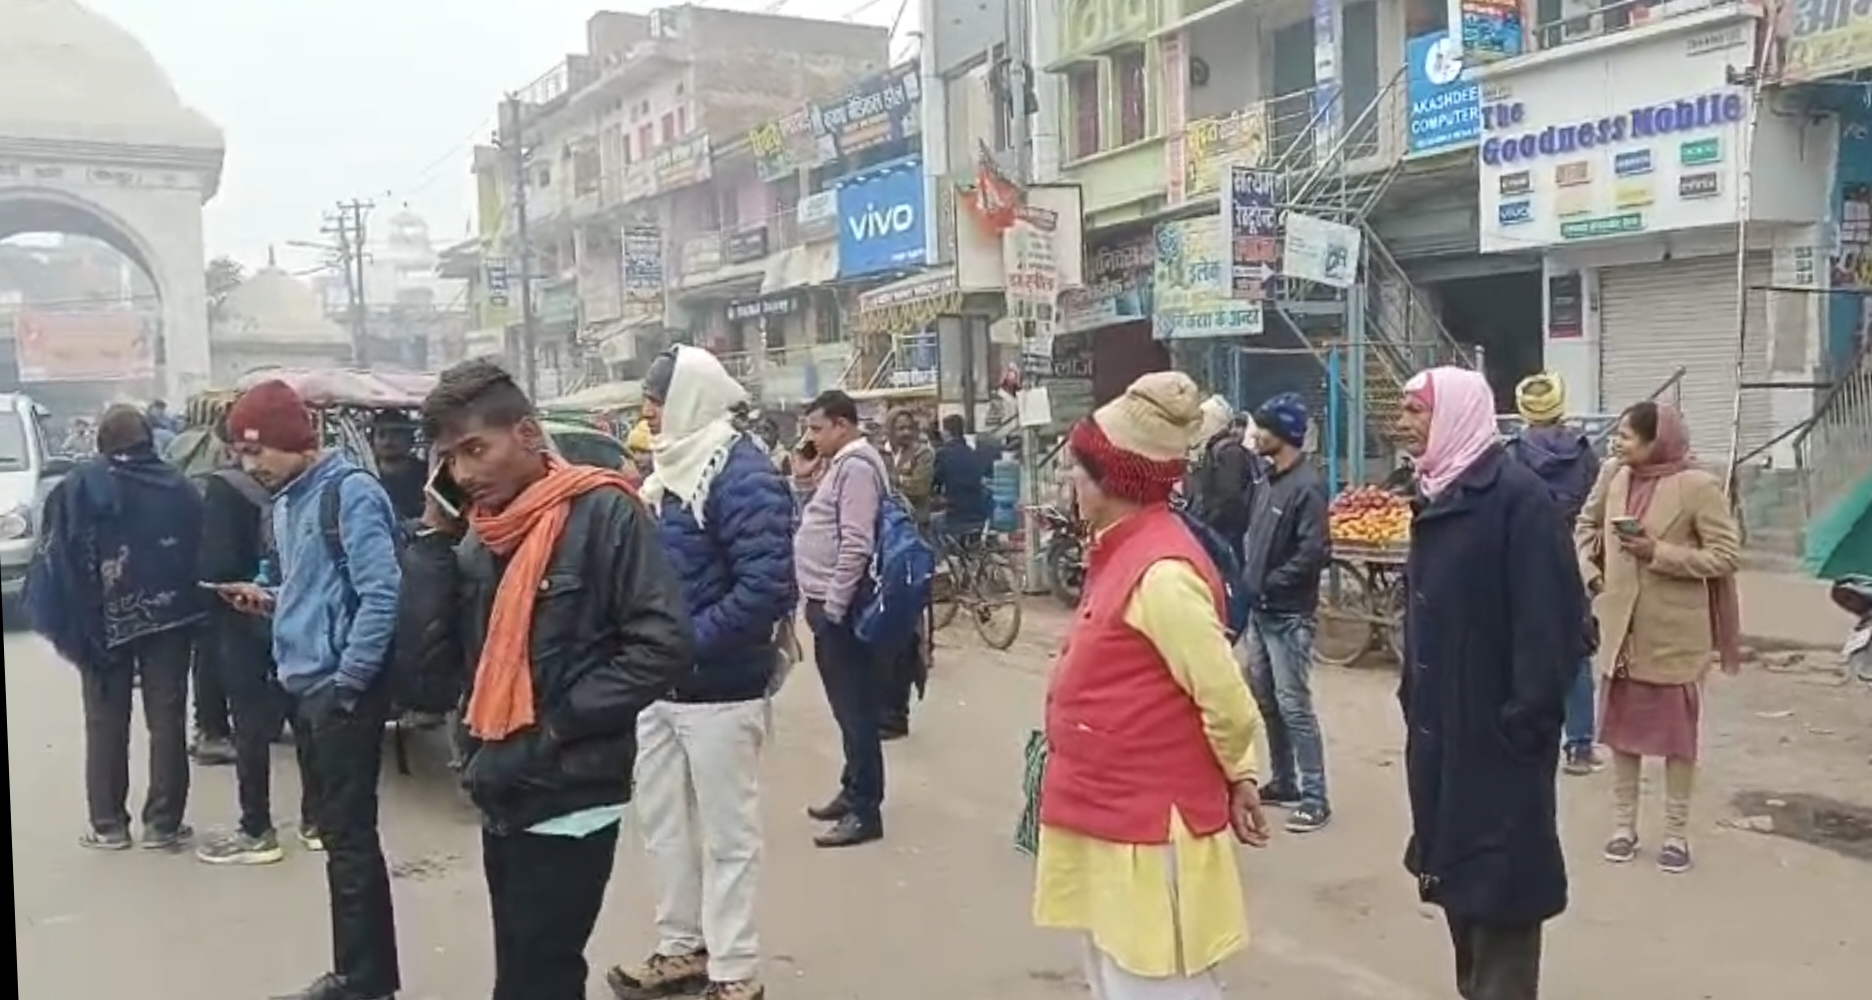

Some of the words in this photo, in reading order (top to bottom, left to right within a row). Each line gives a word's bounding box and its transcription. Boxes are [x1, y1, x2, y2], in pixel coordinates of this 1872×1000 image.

[1481, 102, 1524, 129] The
[1482, 114, 1627, 165] Goodness
[1629, 93, 1743, 138] Mobile
[848, 202, 913, 241] vivo
